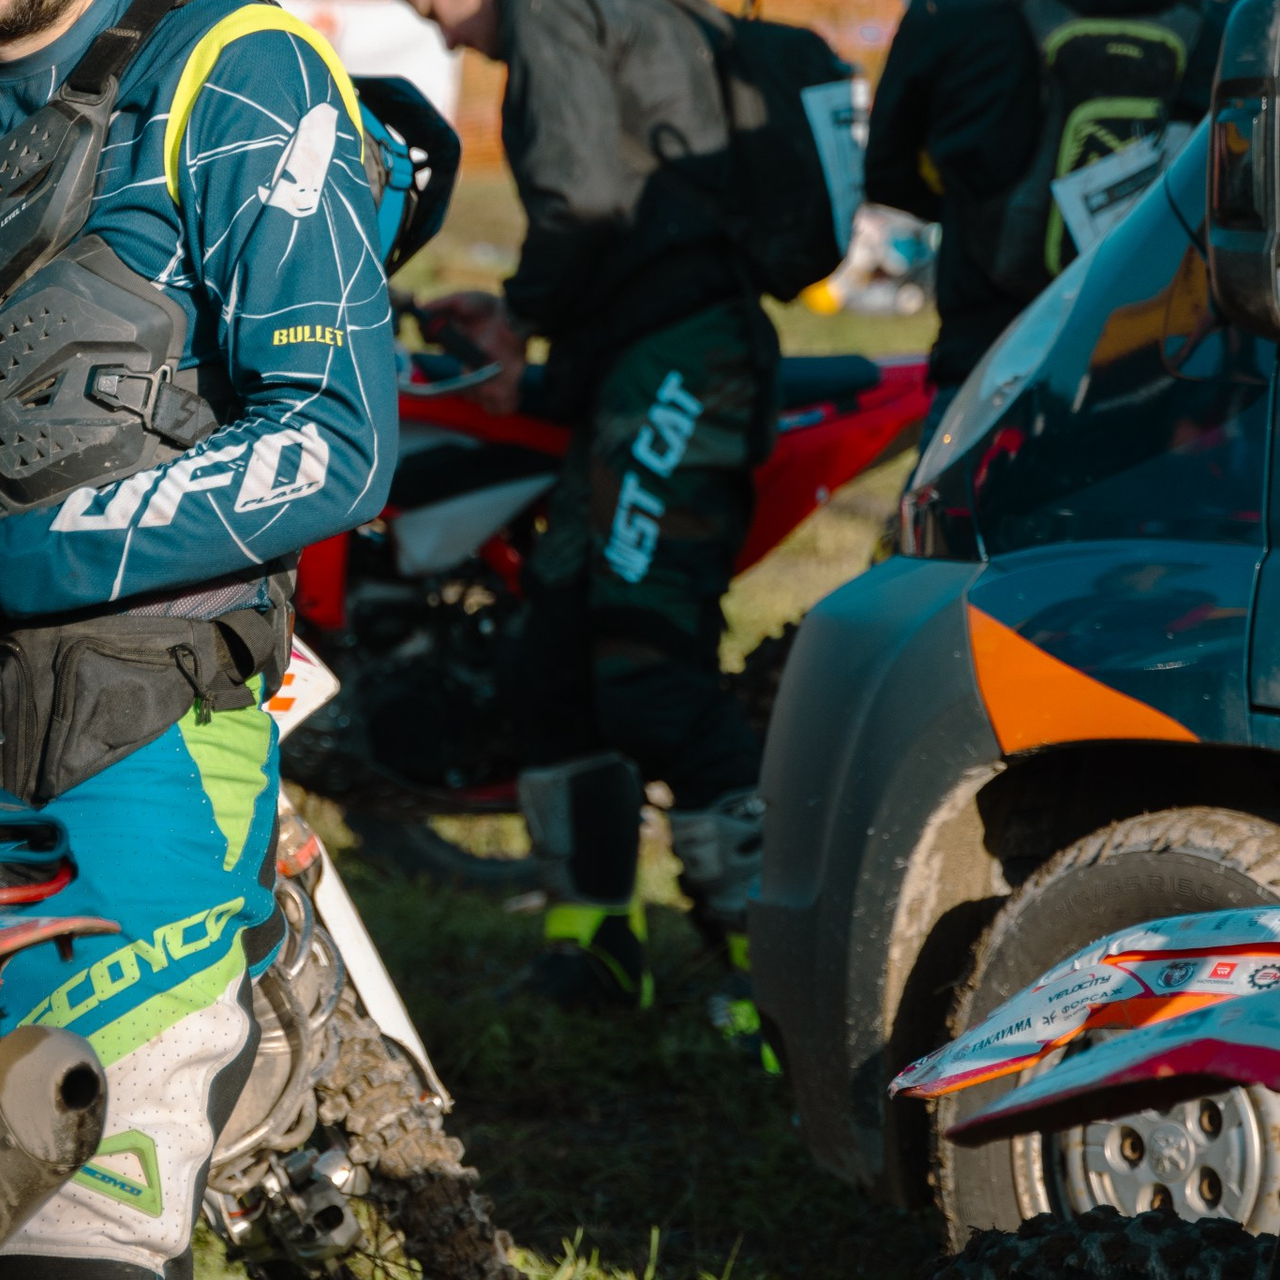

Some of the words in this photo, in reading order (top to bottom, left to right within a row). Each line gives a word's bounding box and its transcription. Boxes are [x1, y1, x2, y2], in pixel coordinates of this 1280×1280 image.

[272, 324, 345, 347] BULLET
[1047, 974, 1112, 1004] VELOCITY
[972, 1017, 1033, 1053] TAKAYAMA
